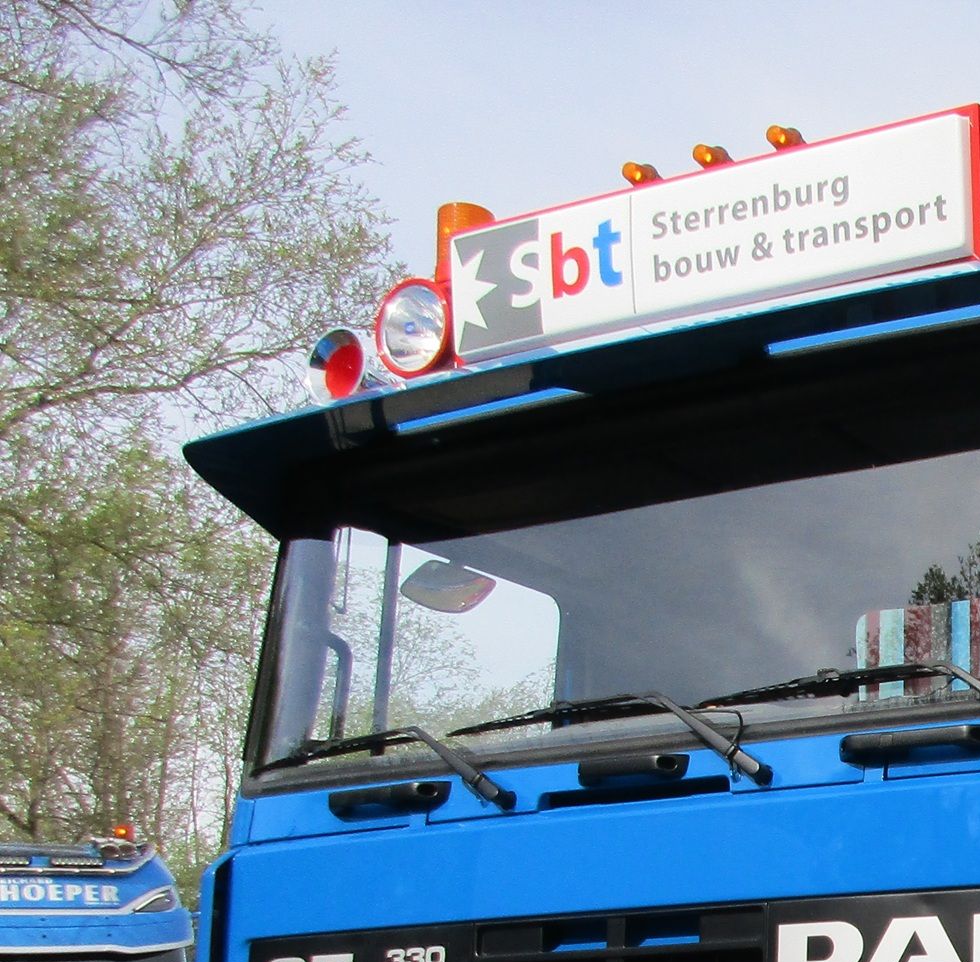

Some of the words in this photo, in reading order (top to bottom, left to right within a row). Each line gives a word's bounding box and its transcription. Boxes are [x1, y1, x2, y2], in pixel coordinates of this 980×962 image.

[652, 175, 850, 239] Sterrenburg
[653, 242, 740, 283] bouw
[751, 233, 773, 260] &
[783, 194, 948, 254] transport
